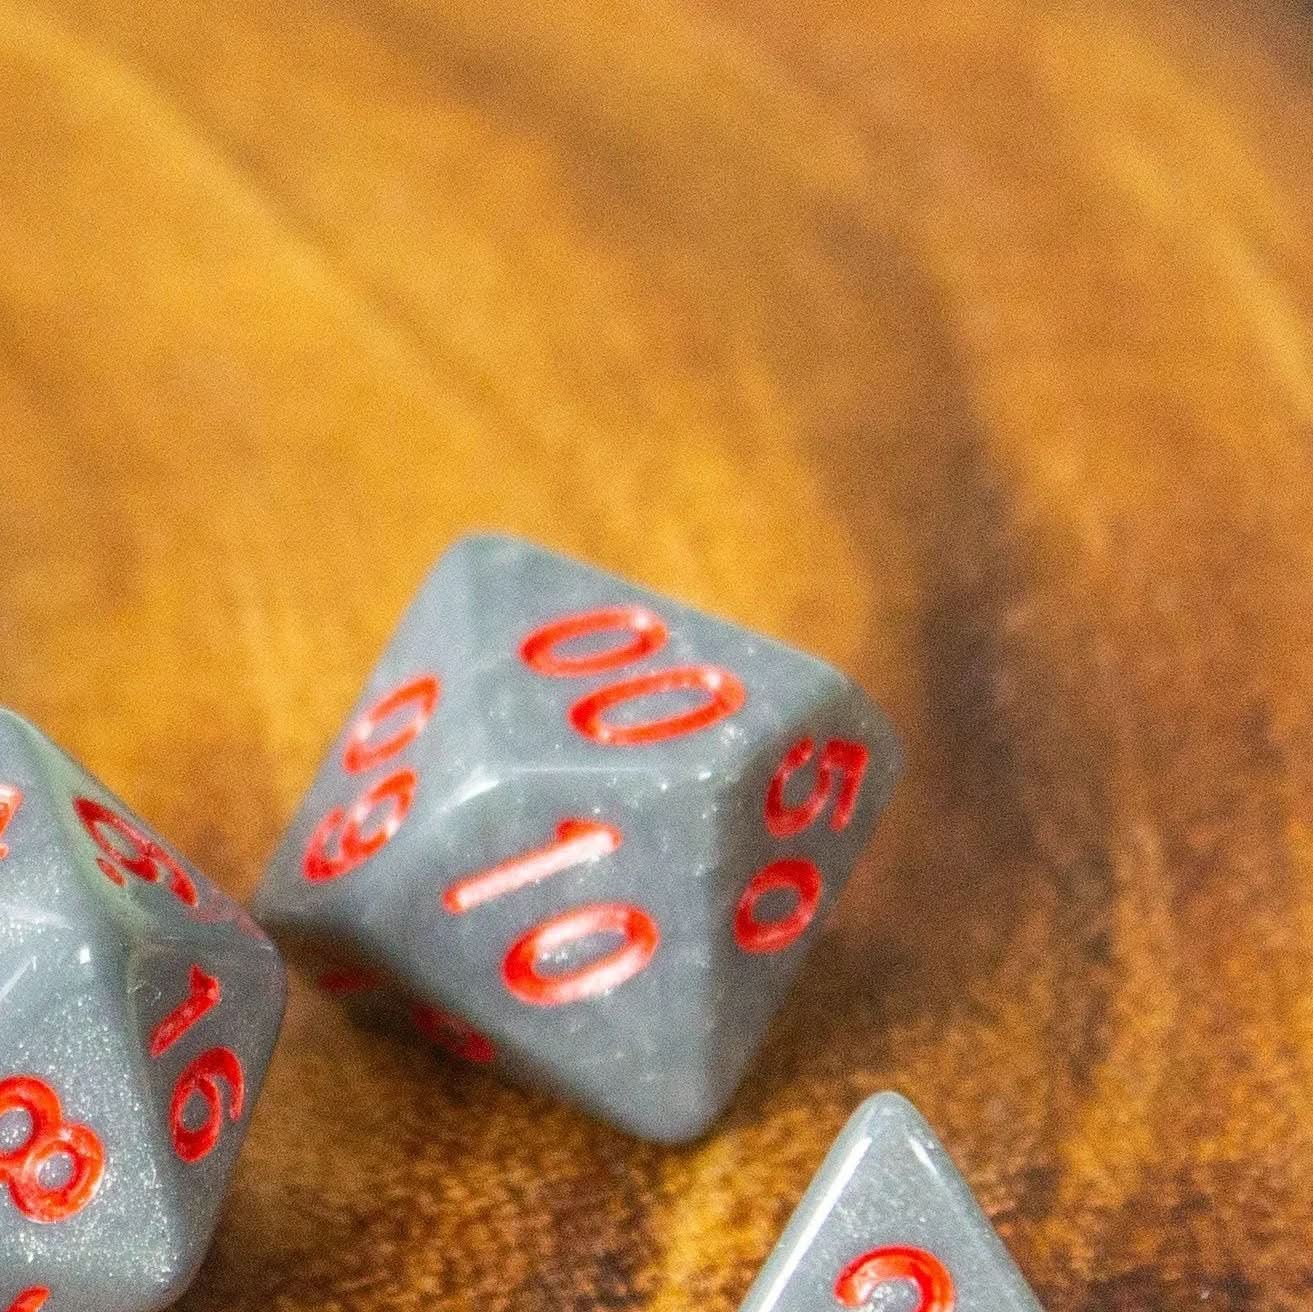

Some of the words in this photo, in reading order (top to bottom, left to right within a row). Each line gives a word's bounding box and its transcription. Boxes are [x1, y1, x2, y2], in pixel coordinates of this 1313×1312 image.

[516, 604, 746, 746] 00
[441, 817, 661, 1006] 10
[732, 735, 871, 956] 50
[149, 963, 246, 1164] 16
